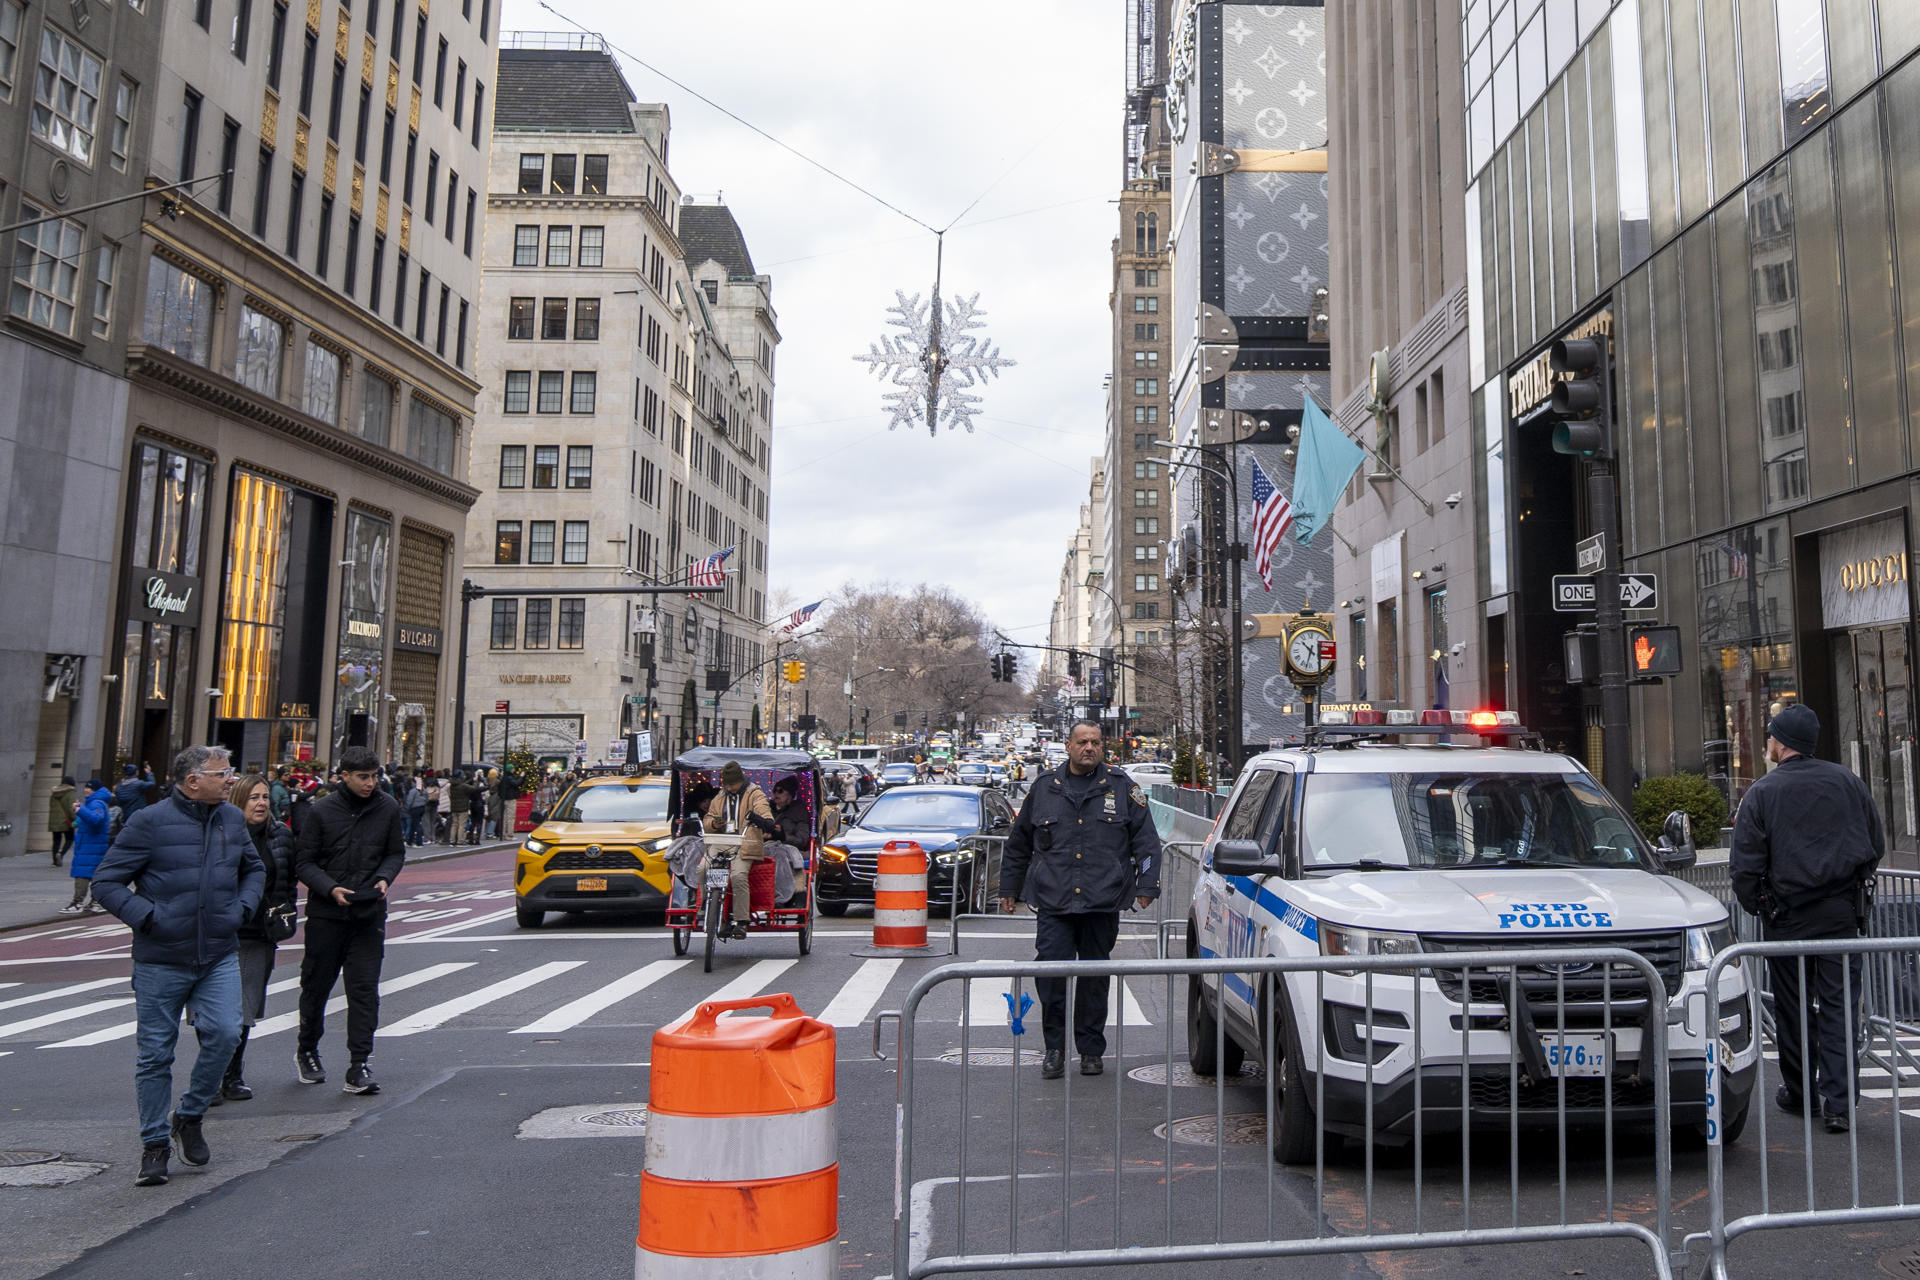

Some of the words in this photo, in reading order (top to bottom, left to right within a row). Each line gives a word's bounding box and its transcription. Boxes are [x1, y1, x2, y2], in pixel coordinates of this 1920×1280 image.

[1840, 552, 1907, 592] GUCCI
[146, 576, 192, 617] Chopard
[1563, 586, 1594, 599] ONE
[1620, 585, 1642, 599] AY
[347, 620, 380, 638] MIKIMOTO
[400, 629, 437, 648] BVLGARI
[499, 674, 514, 684] VAN
[1319, 704, 1350, 712] TIFFANY
[1351, 703, 1358, 712] &
[1510, 903, 1588, 912] NYPD
[1282, 904, 1309, 934] POLICE
[1498, 912, 1613, 929] POLICE
[1542, 1045, 1586, 1066] 576
[1588, 1055, 1603, 1066] 17
[1706, 1042, 1717, 1140] NYPD
